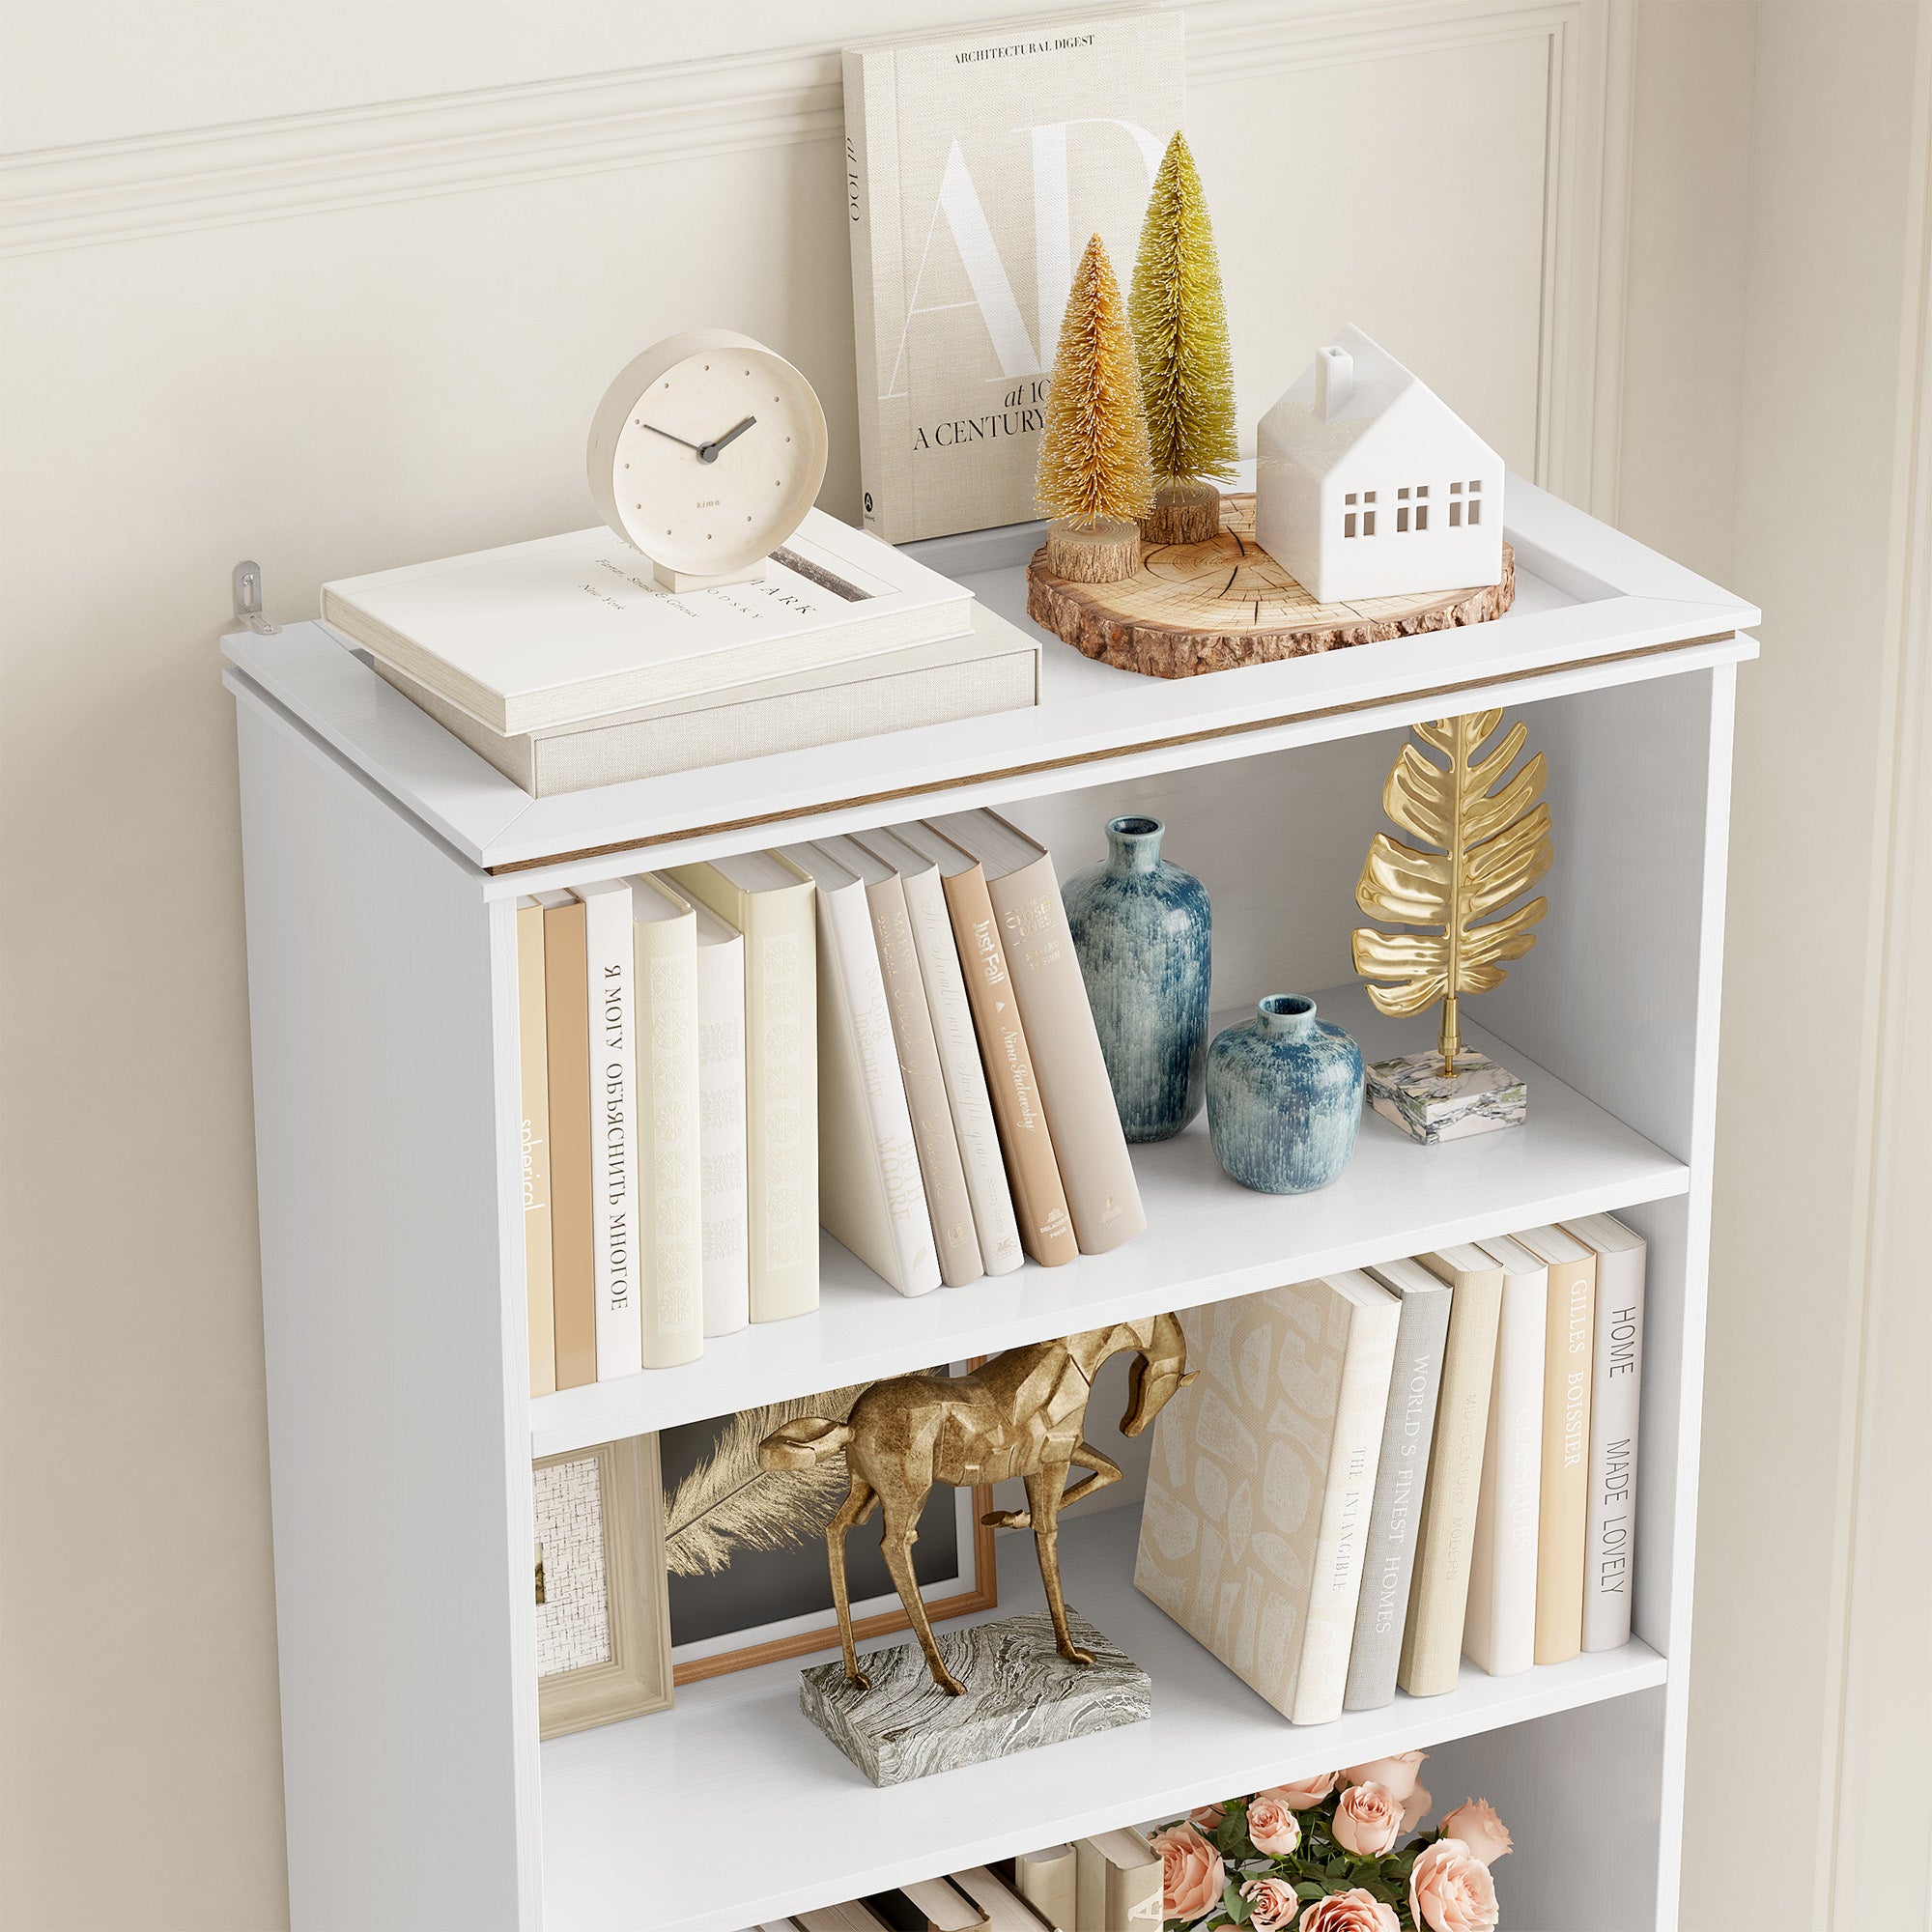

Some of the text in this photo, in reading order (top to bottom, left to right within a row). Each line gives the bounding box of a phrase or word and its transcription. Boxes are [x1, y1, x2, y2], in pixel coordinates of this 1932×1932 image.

[953, 34, 1095, 65] ARCHITECTURAL DIGEST
[849, 172, 861, 222] 100
[1004, 378, 1052, 408] at 10
[913, 409, 1046, 451] A CENTURY
[696, 498, 721, 509] kime
[707, 588, 763, 618] ODSKY
[750, 580, 818, 614] ARK
[981, 954, 1006, 987] Fall
[604, 964, 629, 1312] Я МОГУ ОБЪЯСНИТЬ МНОГОЕ
[877, 1133, 911, 1222] MOORE
[1564, 1279, 1589, 1468] GILLES BOISSIER
[1349, 1447, 1366, 1480] THE
[1601, 1306, 1636, 1595] HOME MADE LOVELY
[1376, 1353, 1430, 1634] WORLD'S FINEST HOMES
